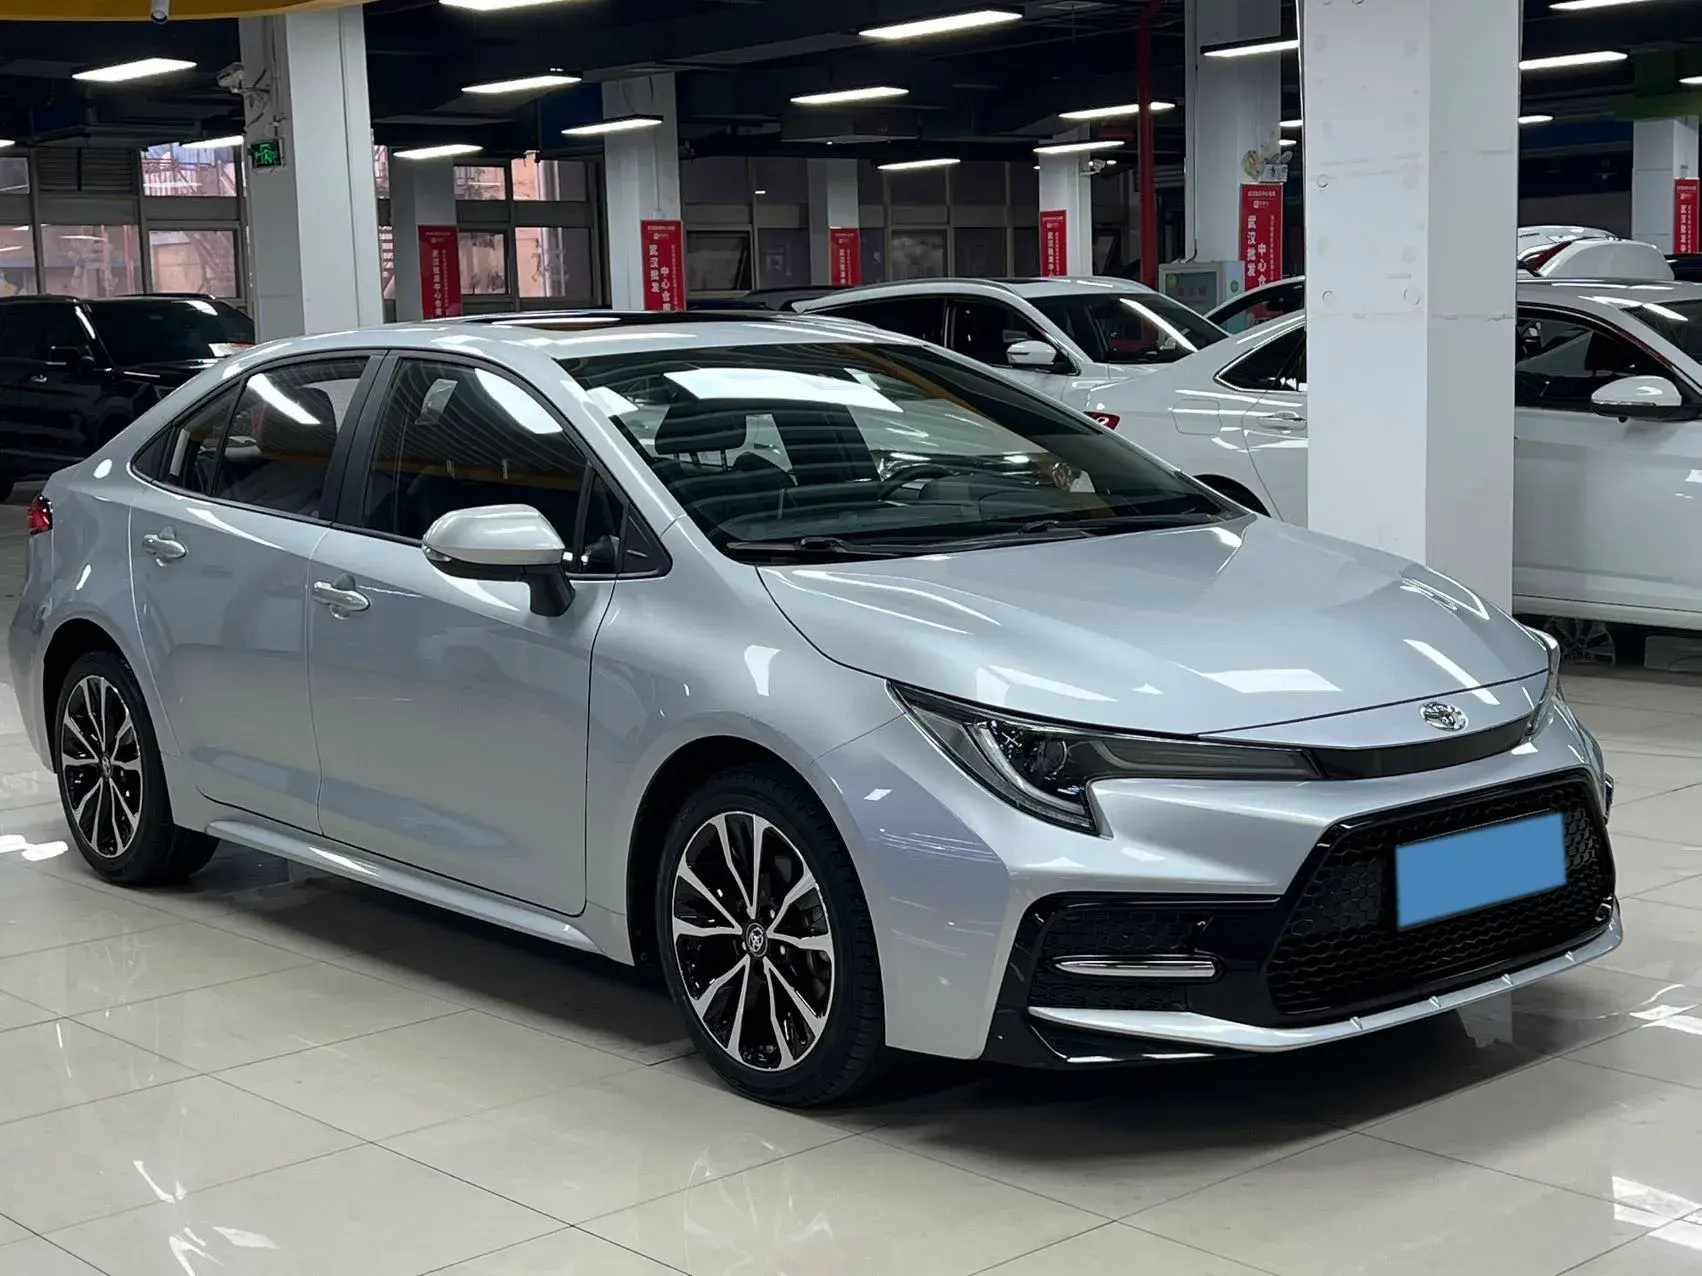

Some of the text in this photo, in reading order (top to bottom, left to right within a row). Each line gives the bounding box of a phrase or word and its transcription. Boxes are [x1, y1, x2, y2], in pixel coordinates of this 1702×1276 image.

[649, 244, 660, 293] 武汉批发
[1247, 215, 1257, 277] 武汉批发
